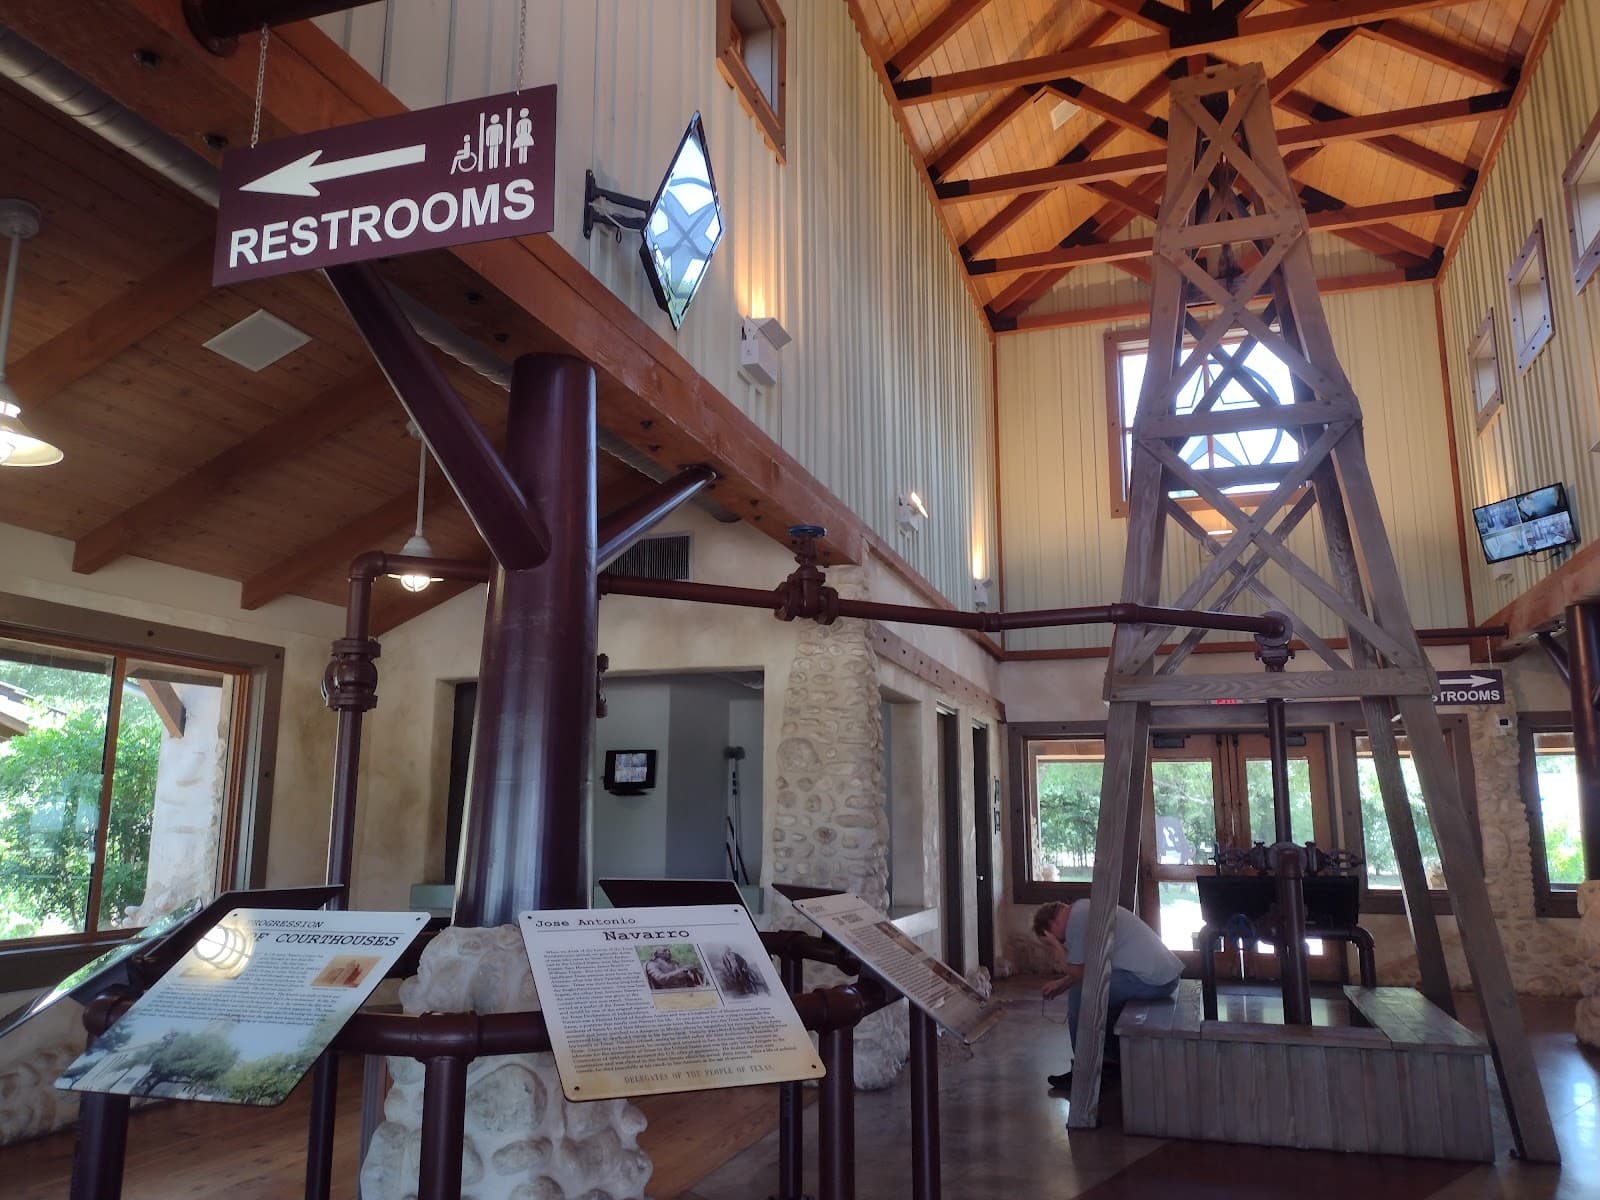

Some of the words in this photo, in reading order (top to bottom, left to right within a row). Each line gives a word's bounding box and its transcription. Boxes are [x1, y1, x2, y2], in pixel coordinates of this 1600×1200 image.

[229, 178, 536, 269] RESTROOMS
[1432, 690, 1501, 702] TROOMS
[579, 918, 636, 926] Antonio
[275, 933, 399, 947] COURTHOUSES
[603, 930, 691, 941] Navarro
[704, 1067, 733, 1077] PEOPLE
[736, 1065, 746, 1073] OF
